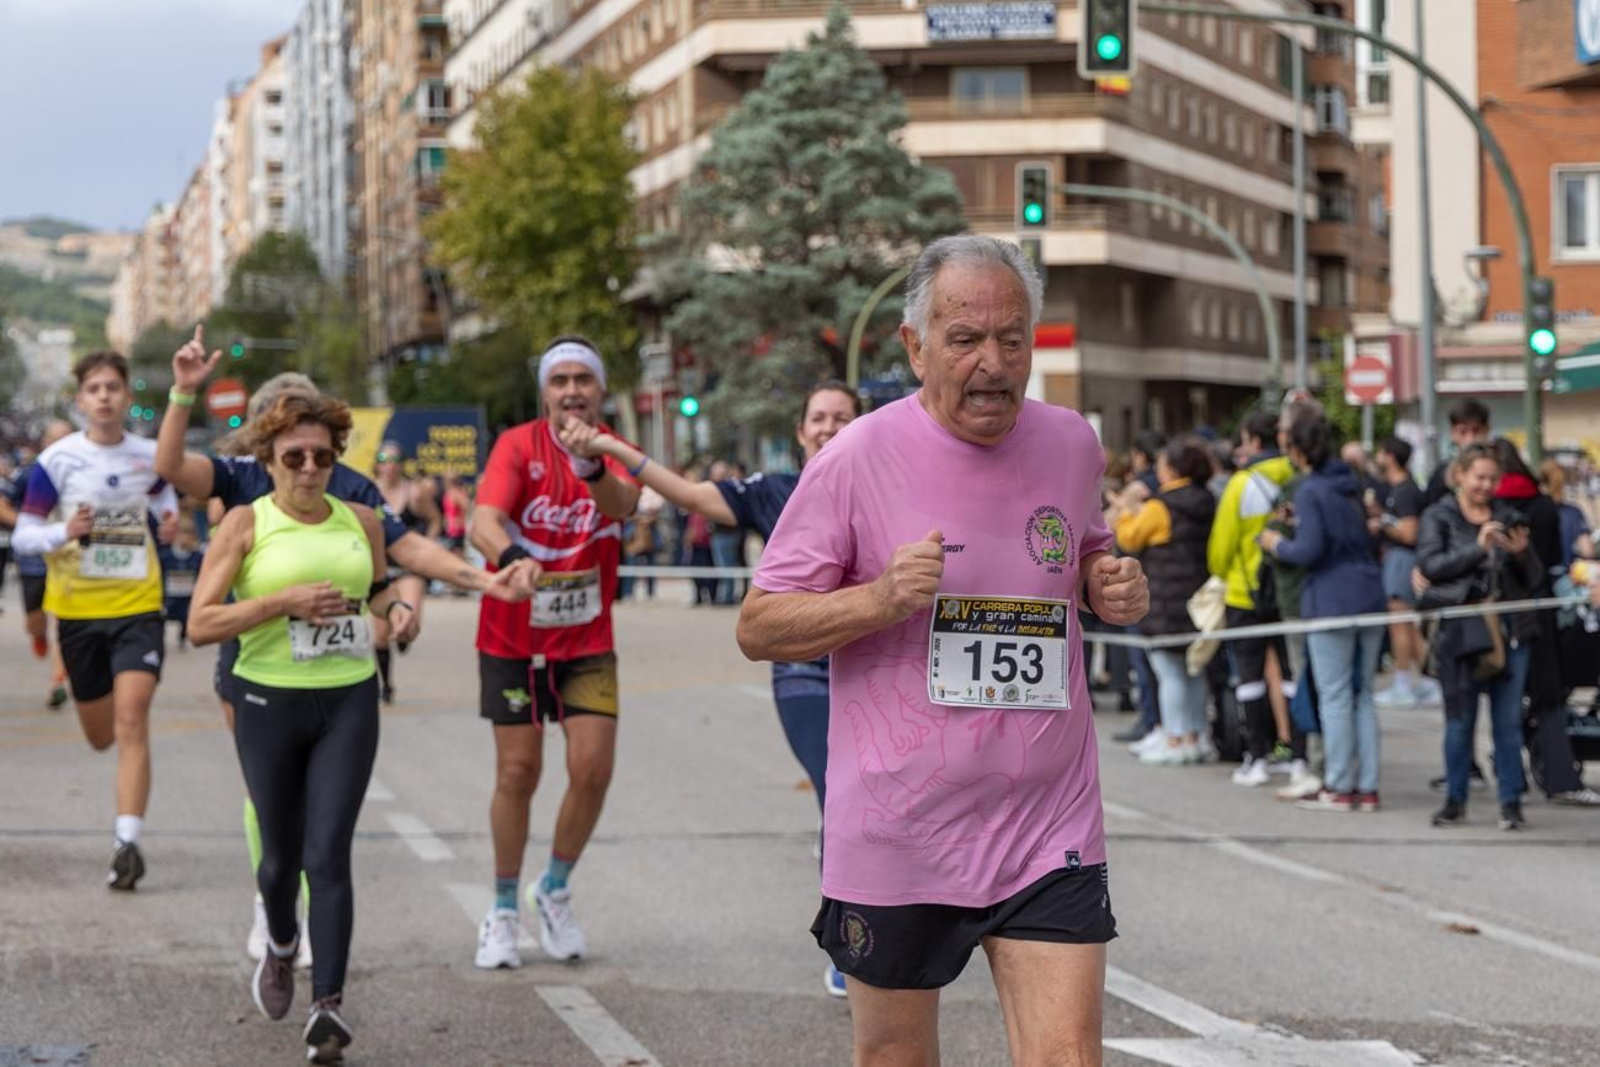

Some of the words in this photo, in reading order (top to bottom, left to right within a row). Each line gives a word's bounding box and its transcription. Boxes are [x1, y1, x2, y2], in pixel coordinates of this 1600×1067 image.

[549, 591, 588, 613] 444
[972, 602, 1021, 612] CARRERA
[1023, 603, 1052, 615] POPUL
[985, 612, 1015, 621] gran
[1020, 613, 1062, 624] camina
[308, 619, 355, 647] 724
[963, 639, 1045, 685] 153
